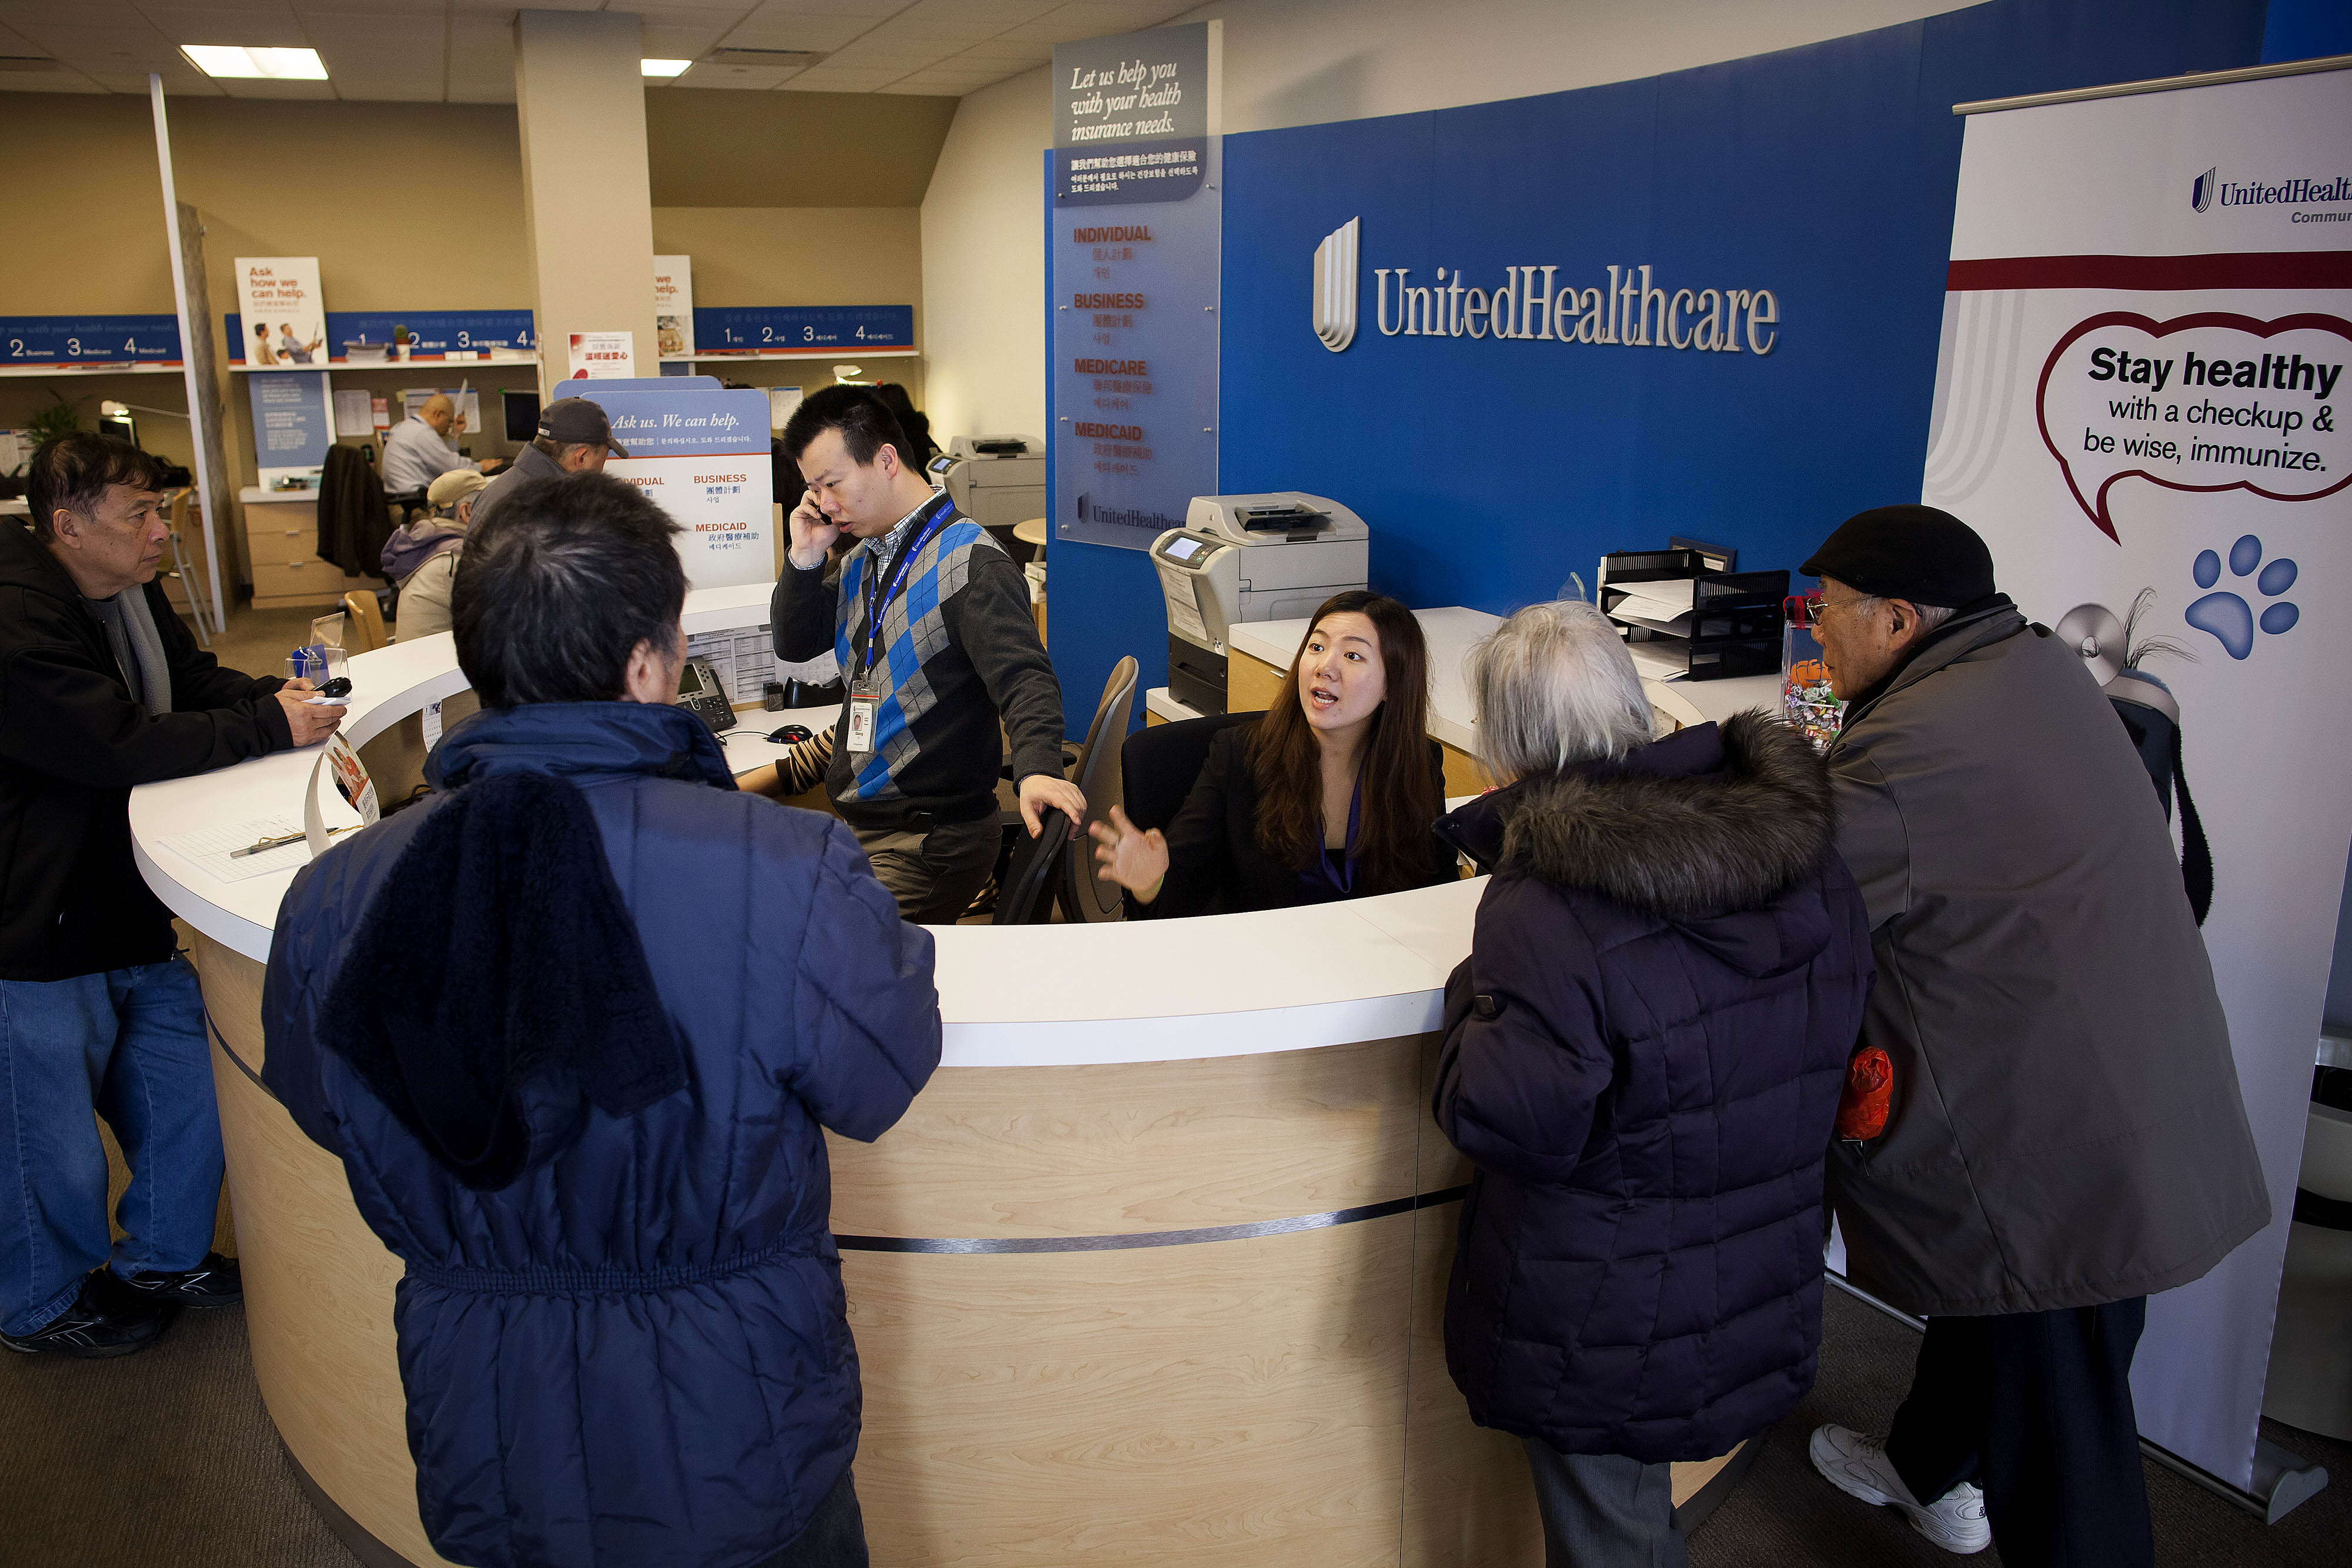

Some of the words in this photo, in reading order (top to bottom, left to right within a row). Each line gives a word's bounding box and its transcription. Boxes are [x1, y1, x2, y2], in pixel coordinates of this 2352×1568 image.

[1071, 67, 1096, 89] Let
[1098, 70, 1115, 86] us
[1117, 59, 1147, 90] help
[1147, 62, 1177, 88] you
[1071, 91, 1103, 115] with
[1103, 94, 1137, 121] your
[1138, 82, 1182, 109] health
[1071, 119, 1132, 142] insurance
[1135, 111, 1175, 135] needs.
[2220, 176, 2352, 207] UnitedHealt
[1074, 225, 1152, 243] INDIVIDUAL
[250, 267, 273, 276] Ask
[250, 279, 276, 287] how
[280, 279, 298, 287] we
[252, 290, 273, 299] can
[277, 287, 306, 299] help.
[1074, 293, 1144, 309] BUSINESS
[1374, 265, 1780, 355] UnitedHealthcare
[407, 332, 420, 349] 2
[457, 330, 470, 349] 3
[516, 330, 529, 347] 4
[724, 327, 731, 343] 1
[761, 326, 773, 343] 2
[803, 325, 814, 342] 3
[855, 325, 866, 340] 4
[10, 339, 24, 357] 2
[67, 337, 81, 356] 3
[124, 337, 138, 355] 4
[1074, 358, 1146, 376] MEDICARE
[2087, 347, 2174, 393] Stay
[2182, 351, 2344, 400] healthy
[612, 414, 637, 429] Ask
[639, 419, 658, 429] us.
[663, 414, 681, 427] We
[684, 416, 707, 427] can
[710, 413, 740, 431] help.
[2109, 394, 2157, 422] with
[2164, 406, 2179, 423] a
[2186, 397, 2303, 437] checkup
[2311, 404, 2334, 433] &
[1075, 422, 1142, 441] MEDICAID
[2083, 427, 2115, 453] be
[2123, 432, 2182, 465] wise,
[2190, 435, 2327, 472] immunize.
[693, 474, 747, 484] BUSINESS
[696, 522, 747, 532] MEDICAID
[709, 542, 742, 550] 메디케이드
